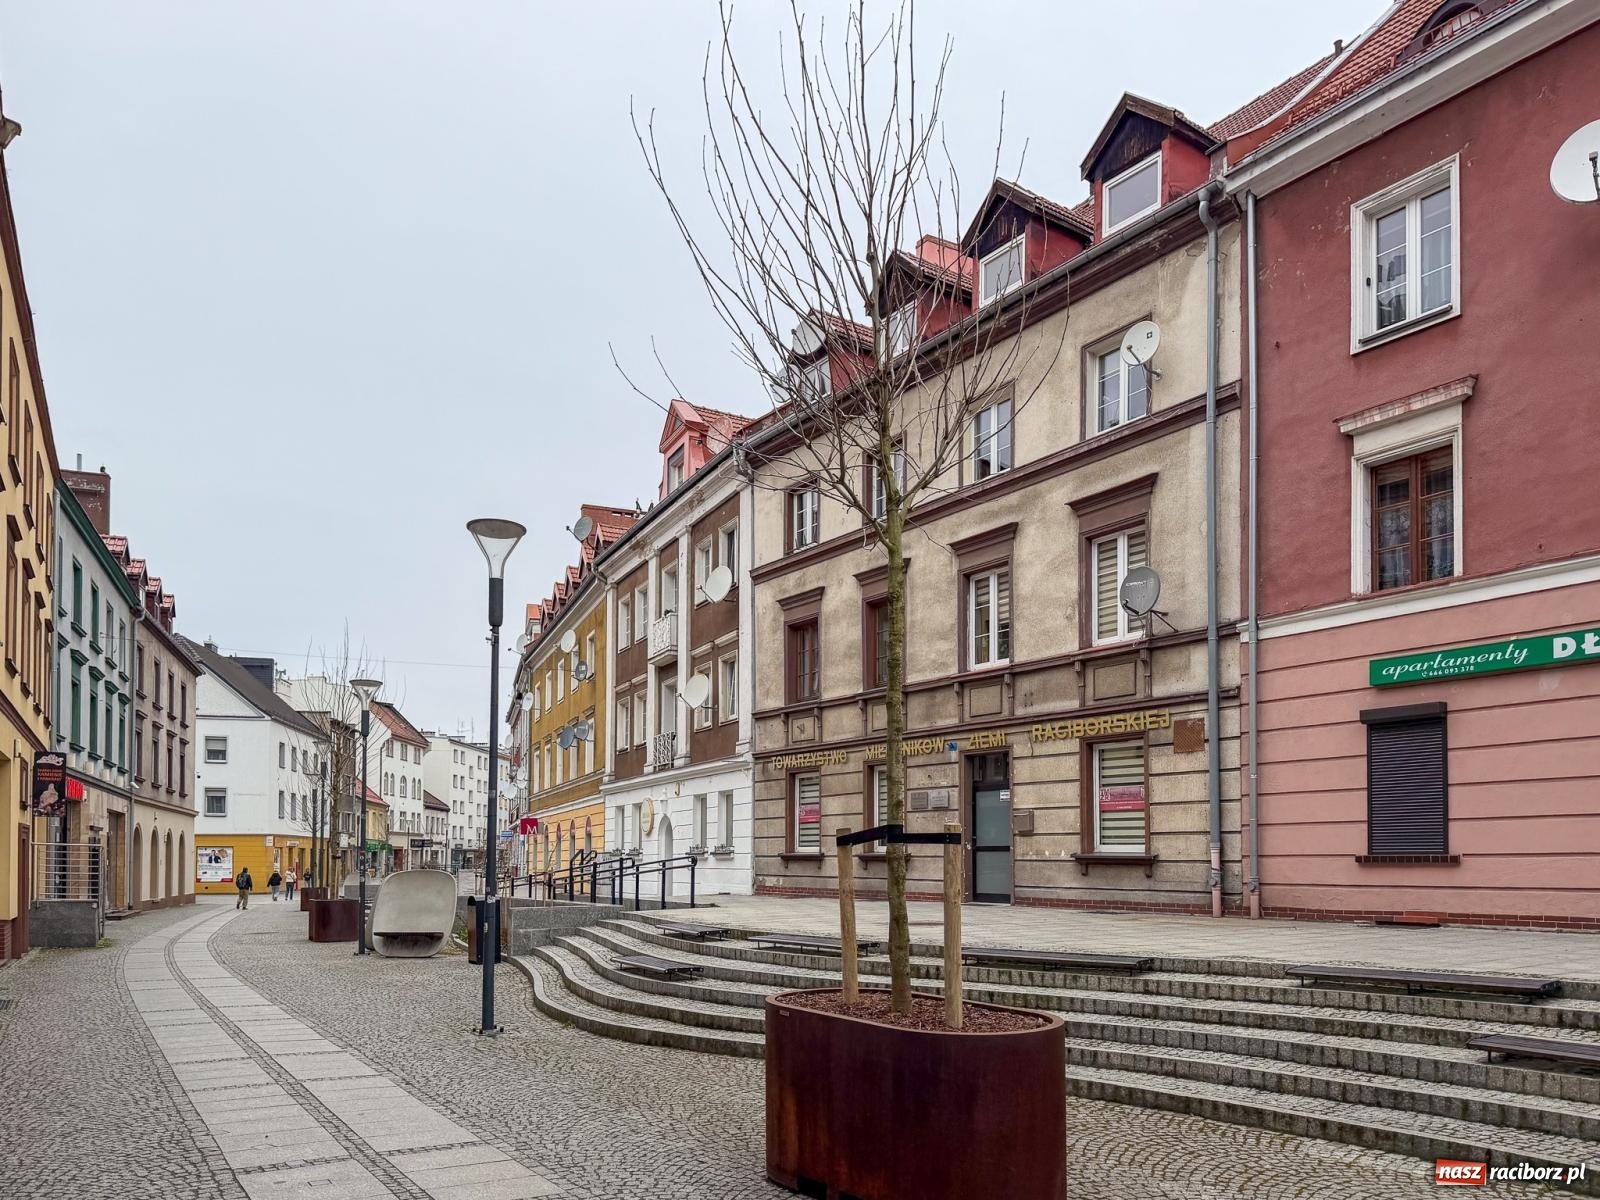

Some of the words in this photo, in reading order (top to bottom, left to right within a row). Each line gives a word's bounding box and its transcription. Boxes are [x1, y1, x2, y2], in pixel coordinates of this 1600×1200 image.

[1381, 643, 1529, 679] apartamenty
[771, 750, 848, 770] TOWARZYSTWO
[967, 731, 1006, 750] ZIEMI
[1031, 708, 1171, 742] RACIBORSKIEJ
[526, 823, 538, 835] M
